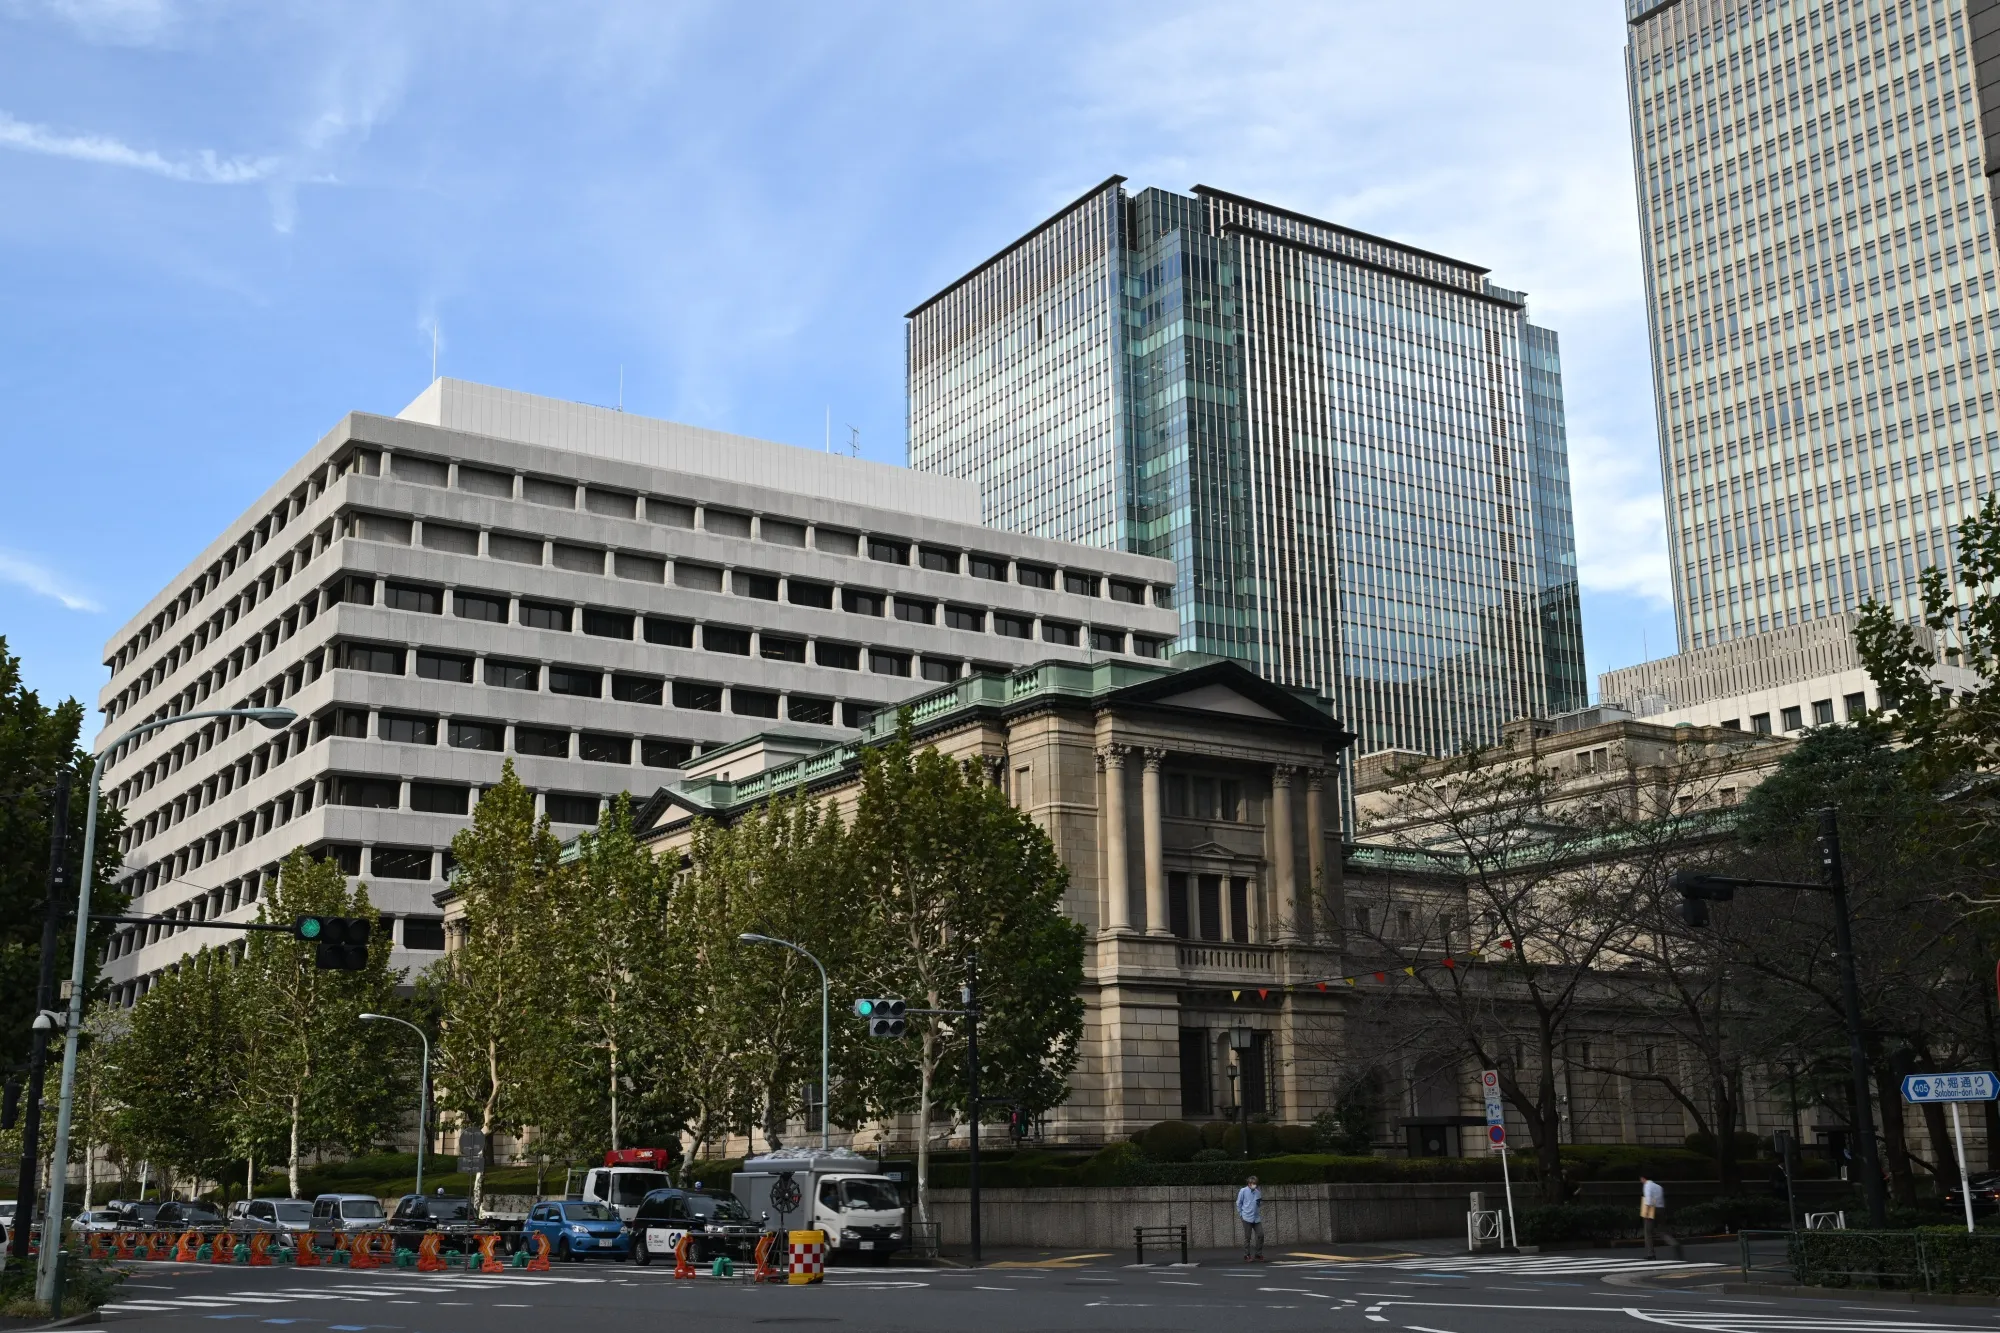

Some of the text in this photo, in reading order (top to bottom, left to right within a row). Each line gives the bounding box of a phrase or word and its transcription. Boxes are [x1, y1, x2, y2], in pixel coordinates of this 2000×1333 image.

[1934, 1076, 1984, 1089] 外堀通り
[1914, 1084, 1929, 1093] 405
[1934, 1088, 1988, 1098] Sotobori-dori Ave.
